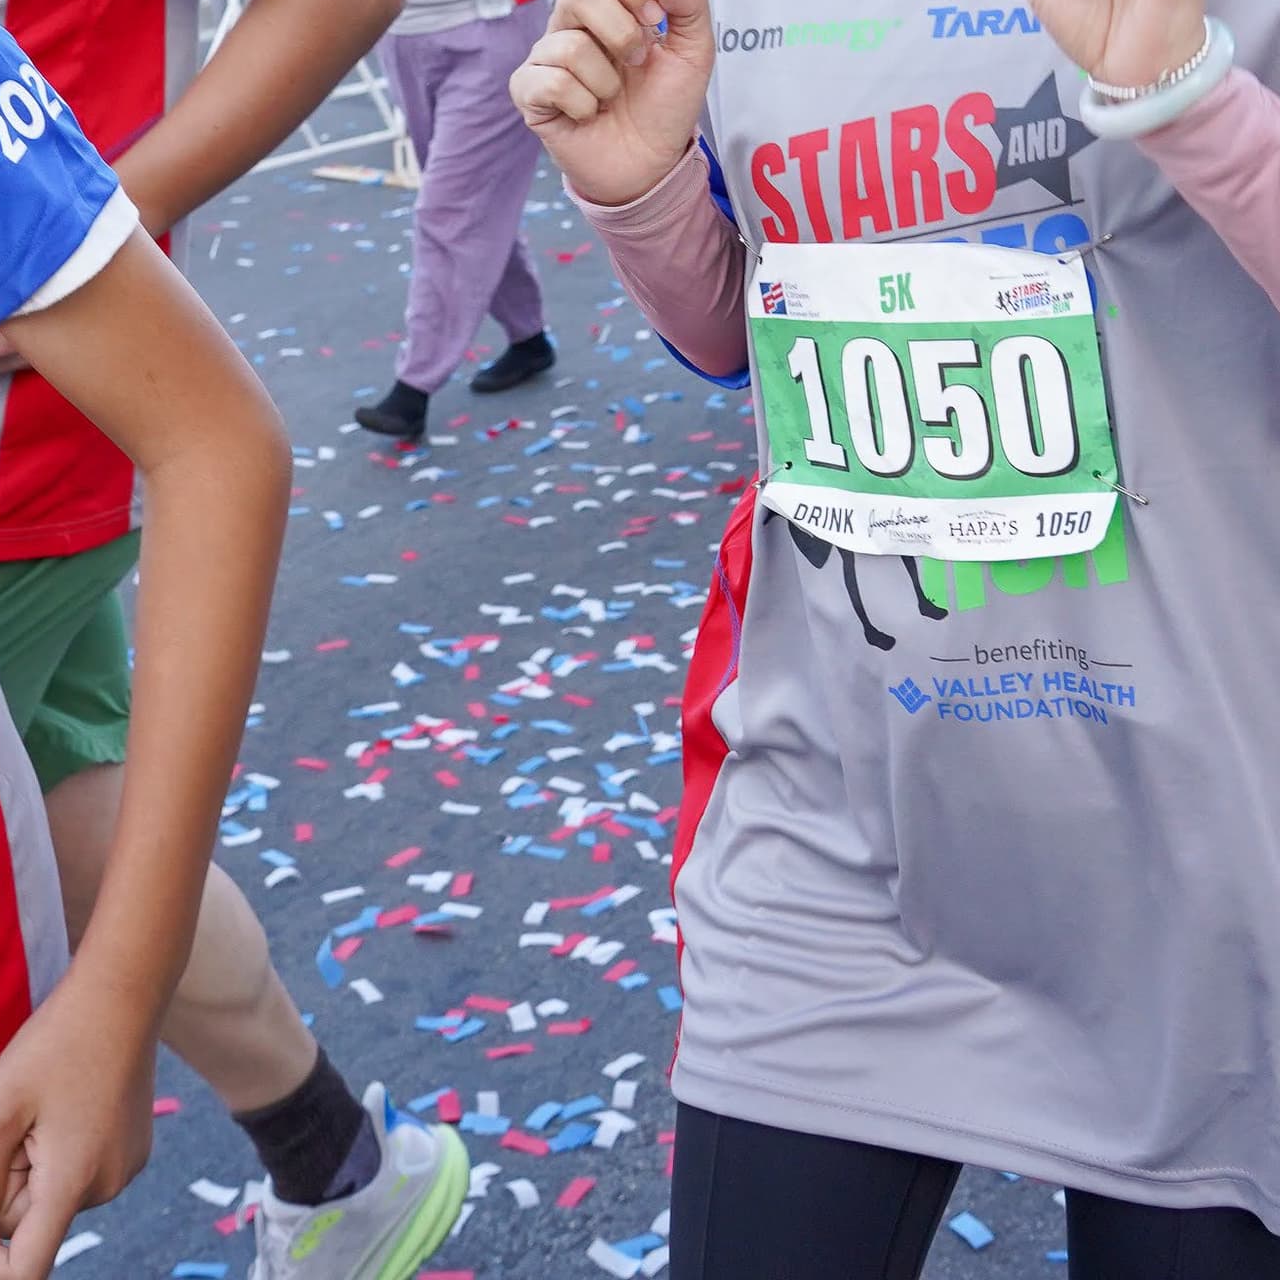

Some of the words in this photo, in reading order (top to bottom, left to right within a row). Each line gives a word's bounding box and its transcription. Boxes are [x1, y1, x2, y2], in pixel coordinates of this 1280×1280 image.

[716, 18, 904, 53] loomenergy
[927, 6, 1042, 39] TARA
[750, 91, 998, 244] STARS
[1007, 116, 1067, 166] AND
[878, 272, 916, 314] 5K
[786, 335, 1081, 480] 1050
[793, 502, 855, 535] DRINK
[948, 519, 1019, 538] HAPA'S
[1035, 510, 1092, 538] 1050
[974, 638, 1090, 671] benefiting
[932, 671, 1034, 698] VALLEY
[1043, 671, 1137, 708] HEALTH
[936, 697, 1110, 726] FOUNDATION
